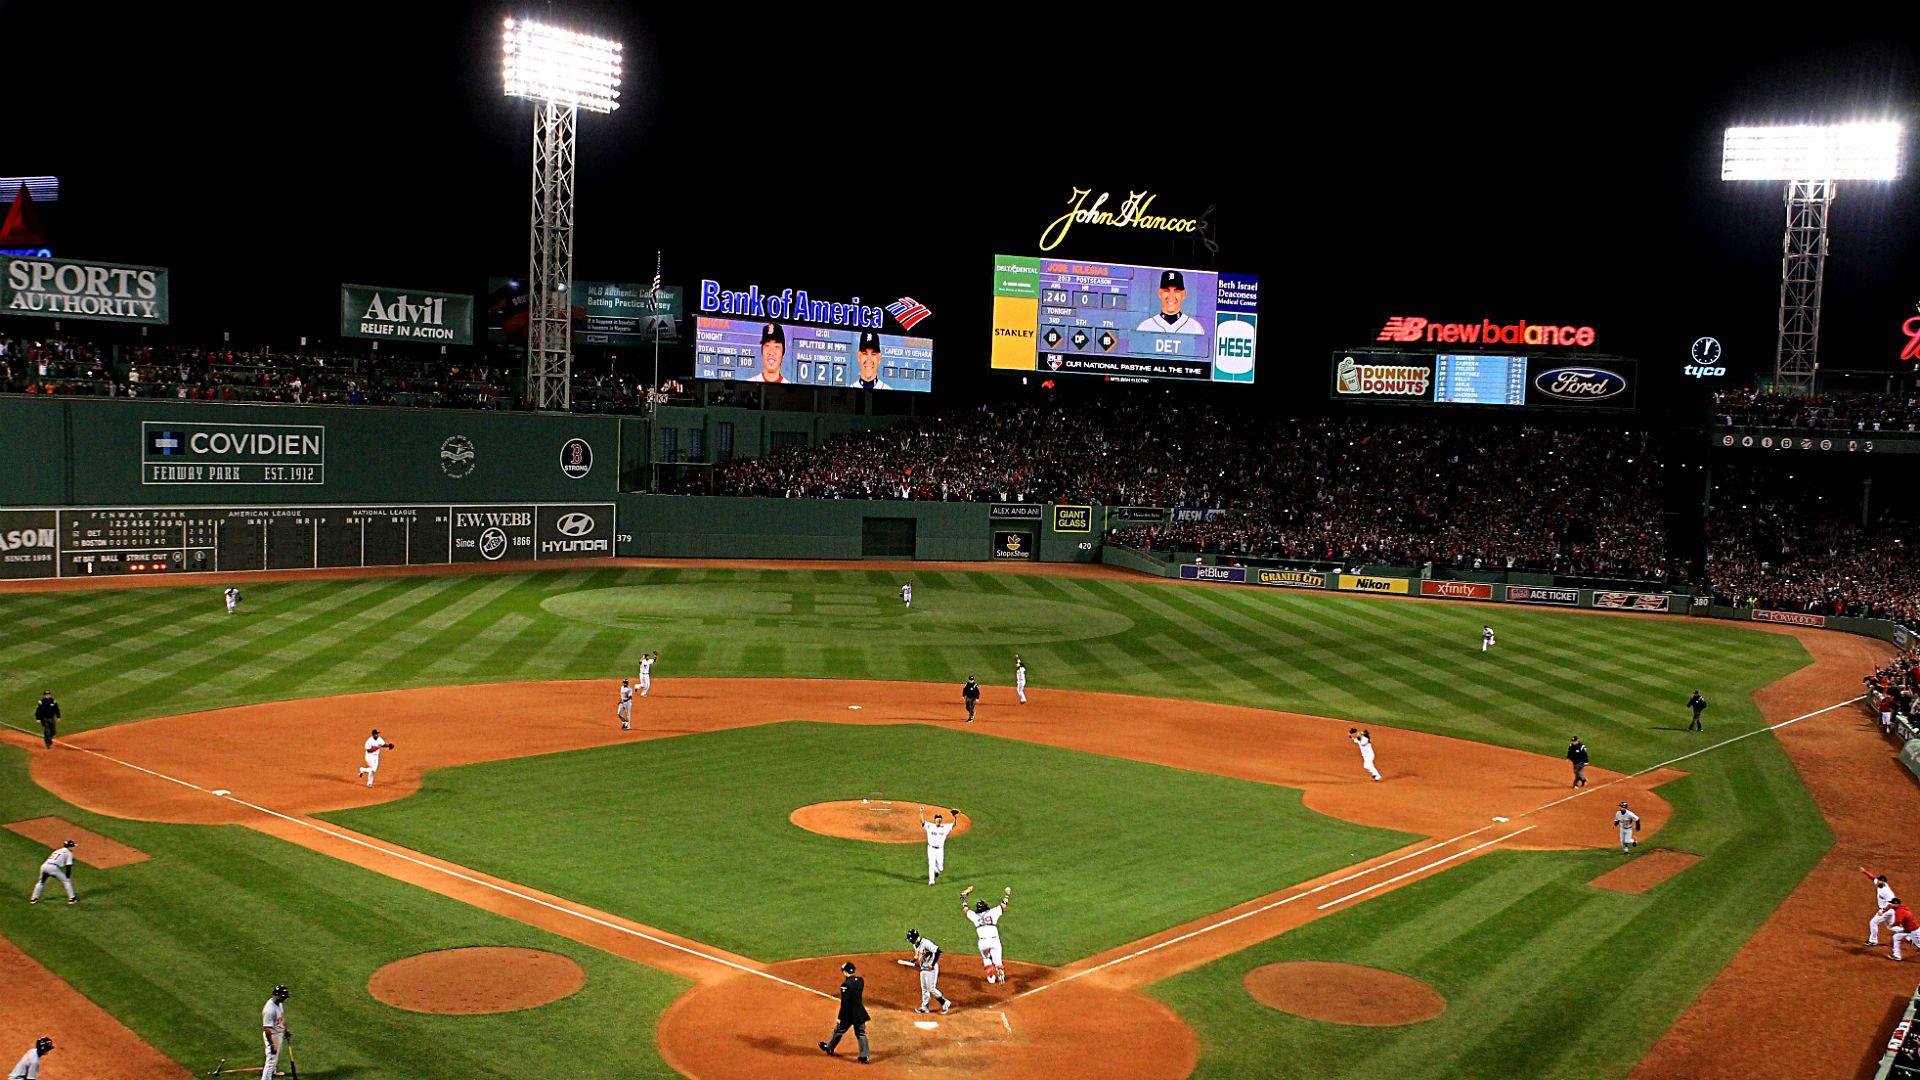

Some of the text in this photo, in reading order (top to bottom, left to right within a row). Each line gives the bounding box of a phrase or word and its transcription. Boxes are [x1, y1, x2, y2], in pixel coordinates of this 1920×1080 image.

[1039, 186, 1113, 251] John
[8, 259, 157, 299] SPORTS
[1218, 279, 1258, 291] Beth Israel
[1044, 293, 1066, 303] .240
[1082, 294, 1088, 304] 0
[1218, 289, 1257, 299] Deaconess
[588, 297, 645, 308] Batting Practice
[700, 279, 884, 330] Bank of America
[1217, 298, 1239, 306] Medical
[362, 291, 444, 326] Advil
[1047, 307, 1072, 316] TONIGHT
[360, 323, 454, 340] RELIEF IN ACTION
[697, 331, 723, 341] TONIGHT
[994, 328, 1034, 338] STANLEY
[799, 340, 826, 350] SPLITTER
[1154, 339, 1182, 354] DET
[1218, 336, 1252, 358] HESS
[741, 357, 752, 366] 100
[1066, 360, 1081, 368] OUR
[1083, 361, 1119, 370] NATIONAL
[1121, 363, 1152, 372] PASTIME
[1185, 367, 1202, 375] TIME
[800, 363, 843, 382] 0 2 2
[1684, 364, 1726, 378] tyco
[1362, 380, 1424, 393] DONUTS
[1550, 371, 1607, 396] Ford
[190, 432, 320, 455] COVIDIEN
[153, 466, 241, 481] FENWAY PARK
[264, 467, 314, 481] EST. 1912
[91, 511, 143, 519] FENWAY
[992, 507, 1010, 515] ALEX
[1011, 507, 1027, 515] AND
[1059, 510, 1086, 519] GIANT
[456, 512, 532, 528] F.W. WEBB
[1058, 519, 1087, 528] GLASS
[456, 538, 476, 548] Since
[512, 536, 532, 547] 1866
[616, 534, 632, 543] 379
[541, 540, 609, 553] HYUNDAI
[1077, 542, 1092, 550] 420
[101, 554, 119, 562] BALL
[126, 553, 151, 561] STRIKE
[152, 553, 168, 561] OUT
[1260, 572, 1302, 582] GRANITE
[1355, 578, 1390, 590] Nikon
[1437, 581, 1475, 596] xfinity
[1530, 590, 1548, 600] ACE
[1549, 591, 1577, 601] TICKET
